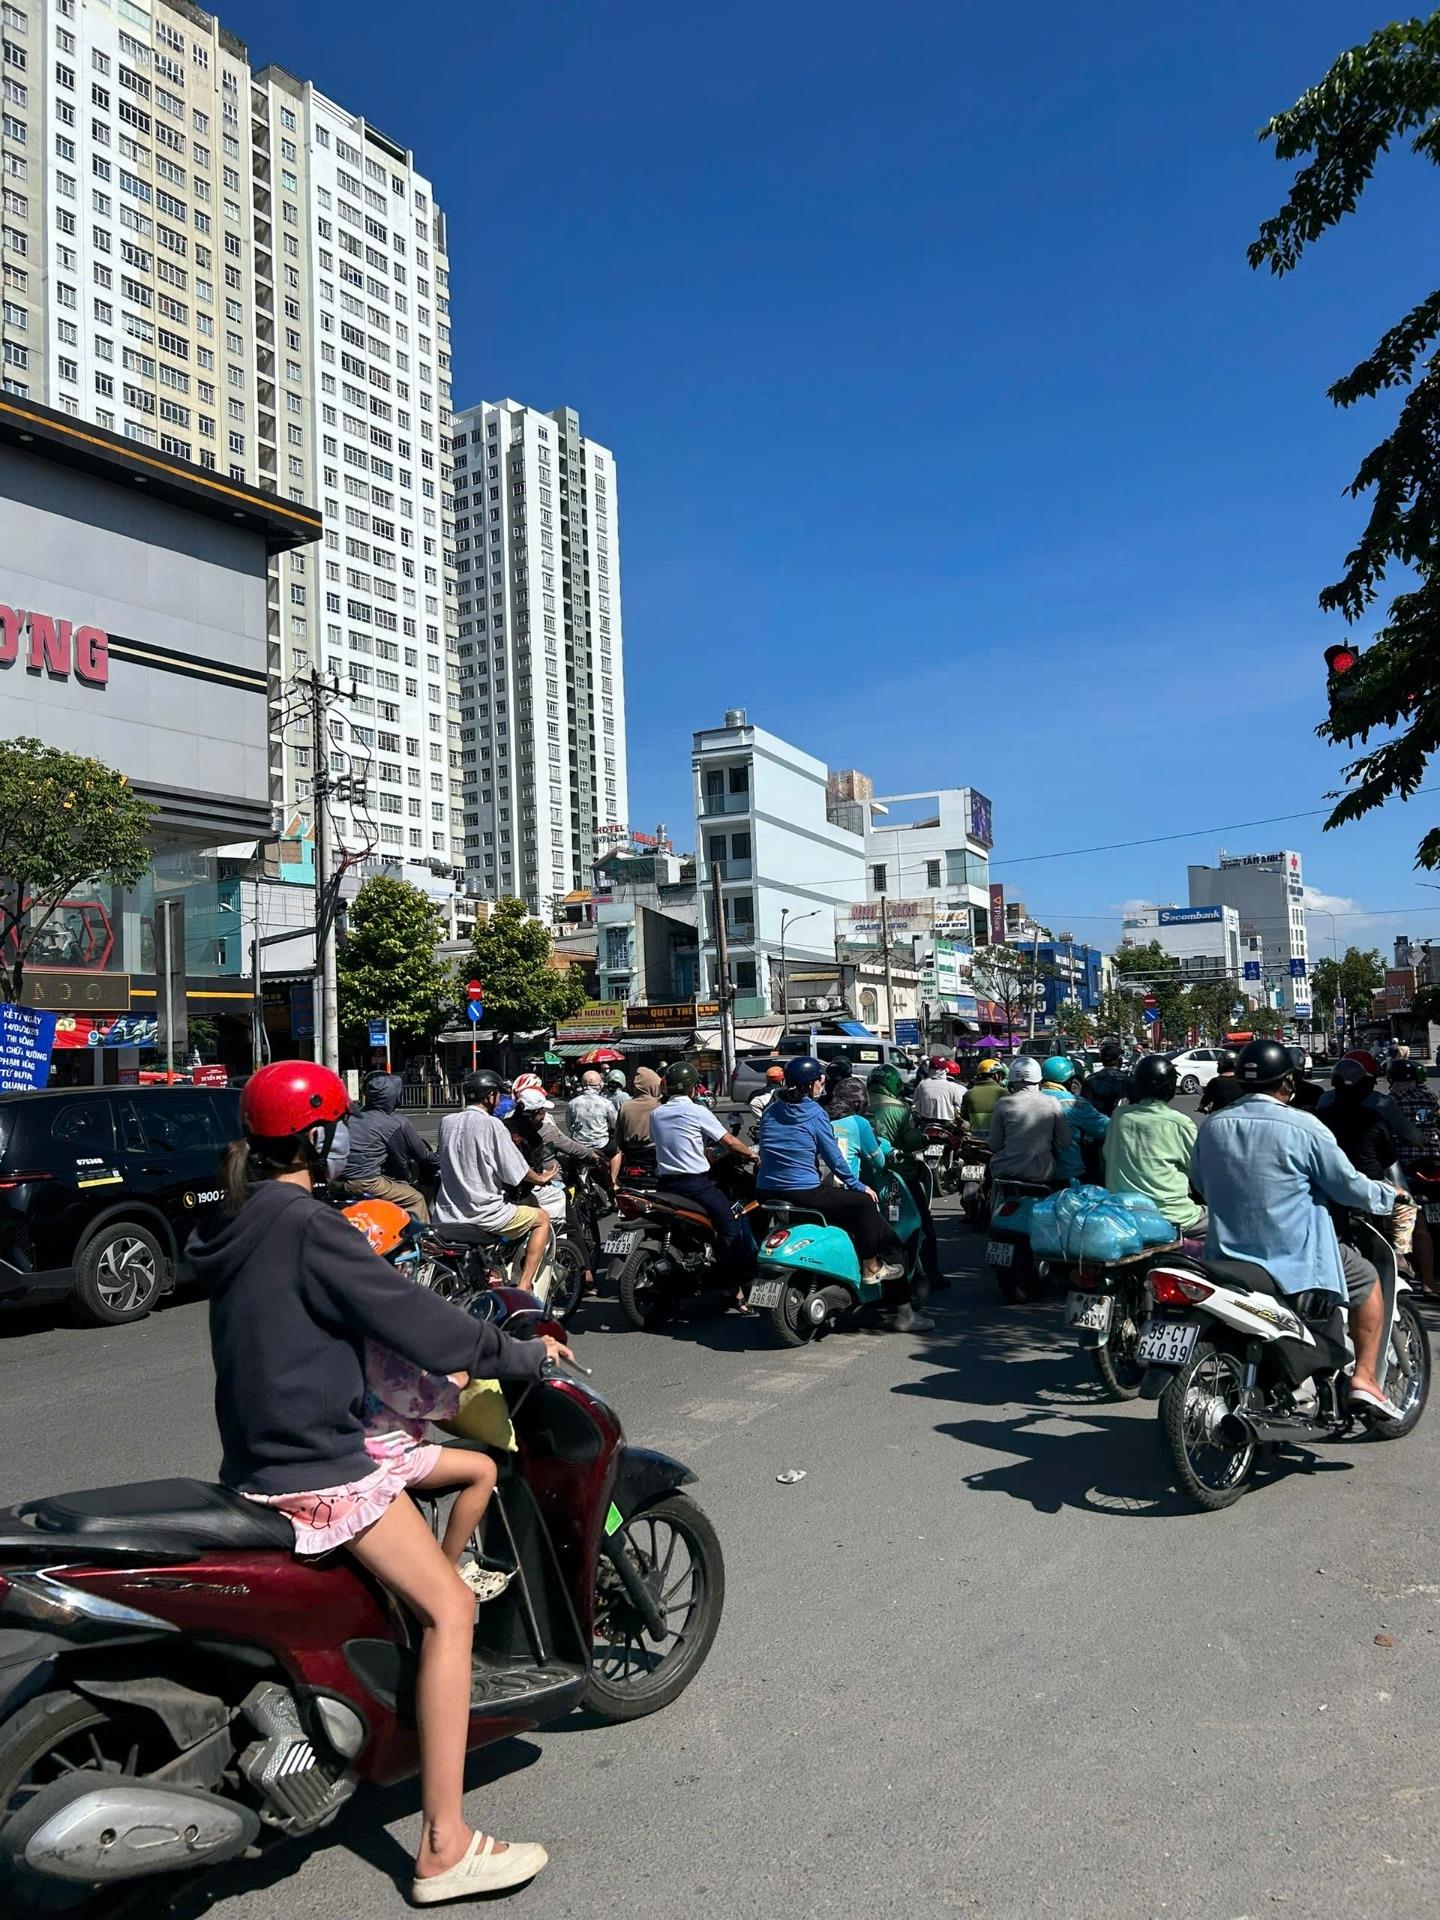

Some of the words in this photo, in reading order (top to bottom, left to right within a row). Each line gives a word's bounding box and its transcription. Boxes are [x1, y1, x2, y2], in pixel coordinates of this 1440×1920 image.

[595, 825, 625, 834] HOTEL
[1261, 854, 1279, 863] ANH
[1161, 909, 1220, 922] Sacombank
[197, 1190, 219, 1203] 1900
[1149, 1323, 1188, 1343] 59-C1
[1139, 1341, 1188, 1362] 640.99
